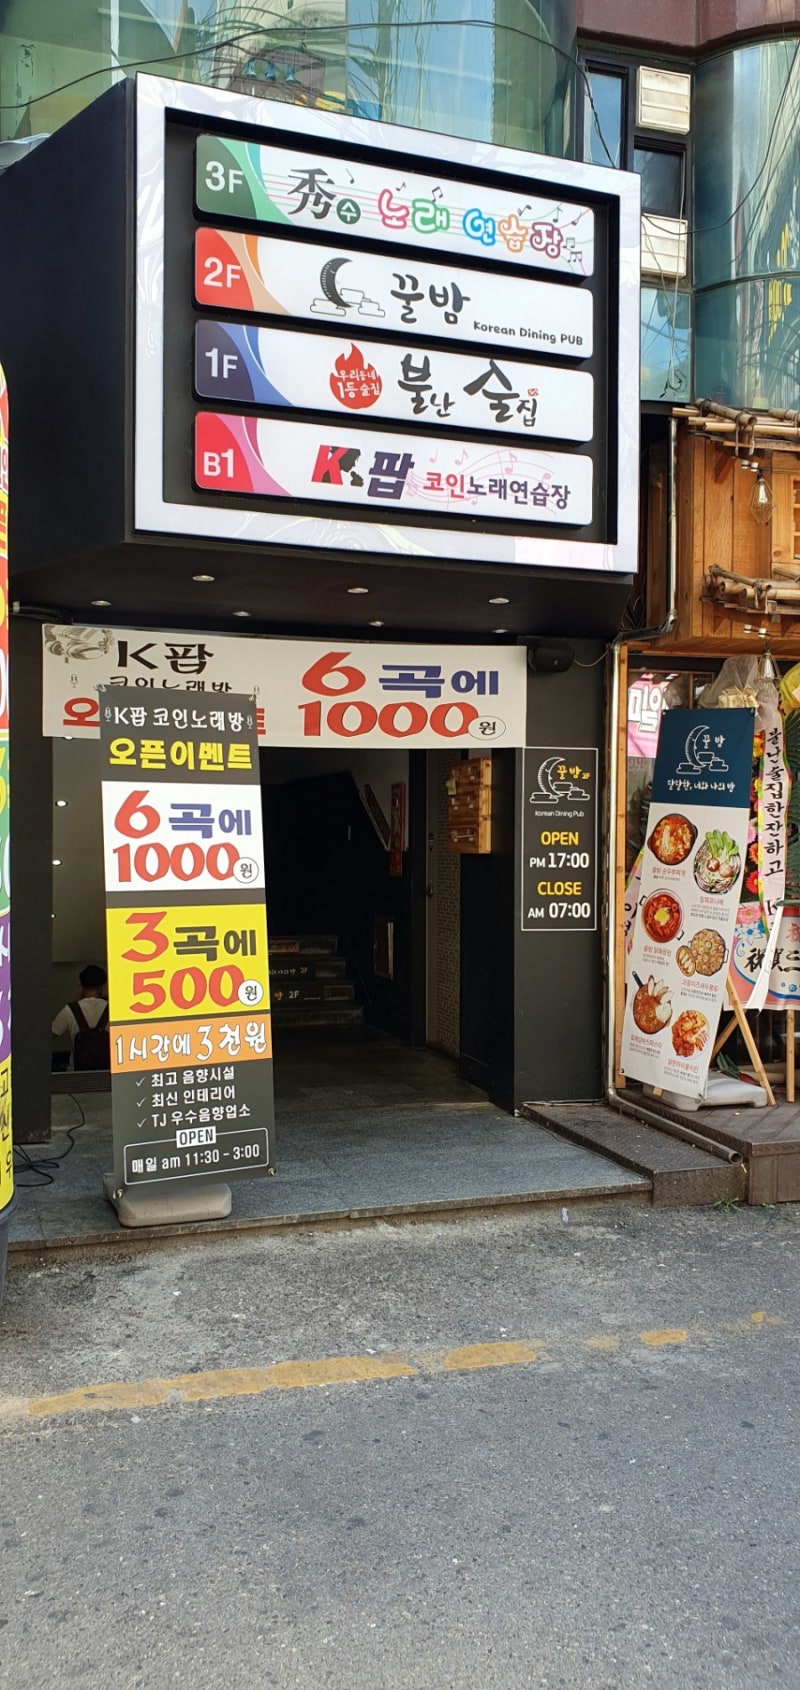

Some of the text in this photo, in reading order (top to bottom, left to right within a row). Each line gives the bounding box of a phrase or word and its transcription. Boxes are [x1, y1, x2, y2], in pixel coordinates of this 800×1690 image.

[205, 160, 244, 193] 3F
[378, 188, 564, 259] 노래 연습장
[203, 257, 242, 288] 2F
[390, 273, 471, 324] 꿀밤
[473, 320, 583, 346] Korean Dining PUB
[205, 347, 238, 379] 1F
[336, 368, 378, 382] 우리동네
[337, 381, 380, 399] 1등 술집
[397, 353, 538, 427] 불난 술집
[203, 449, 235, 479] B1
[423, 471, 571, 511] 코인노래연습장
[117, 640, 215, 675] K팝
[301, 651, 367, 698] 6
[114, 706, 148, 728] K팝
[153, 707, 244, 732] 코인노래방
[109, 737, 253, 772] 오픈이벤트
[114, 790, 161, 839] 6
[555, 810, 573, 818] Dining
[541, 831, 580, 846] OPEN
[529, 853, 590, 869] PM 17:00
[537, 881, 582, 896] CLOSE
[528, 902, 591, 919] AM 07:00
[121, 911, 169, 962] 3
[115, 1031, 191, 1065] 1시간에
[151, 1065, 235, 1088] 최고 음향시설
[152, 1085, 236, 1108] 최신 인테리어
[152, 1103, 251, 1128] TJ 우수음향업소
[179, 1128, 214, 1146] OPEN
[132, 1156, 158, 1174] 매일
[161, 1156, 182, 1170] am
[185, 1149, 220, 1167] 11:30
[233, 1144, 260, 1160] 3:00
